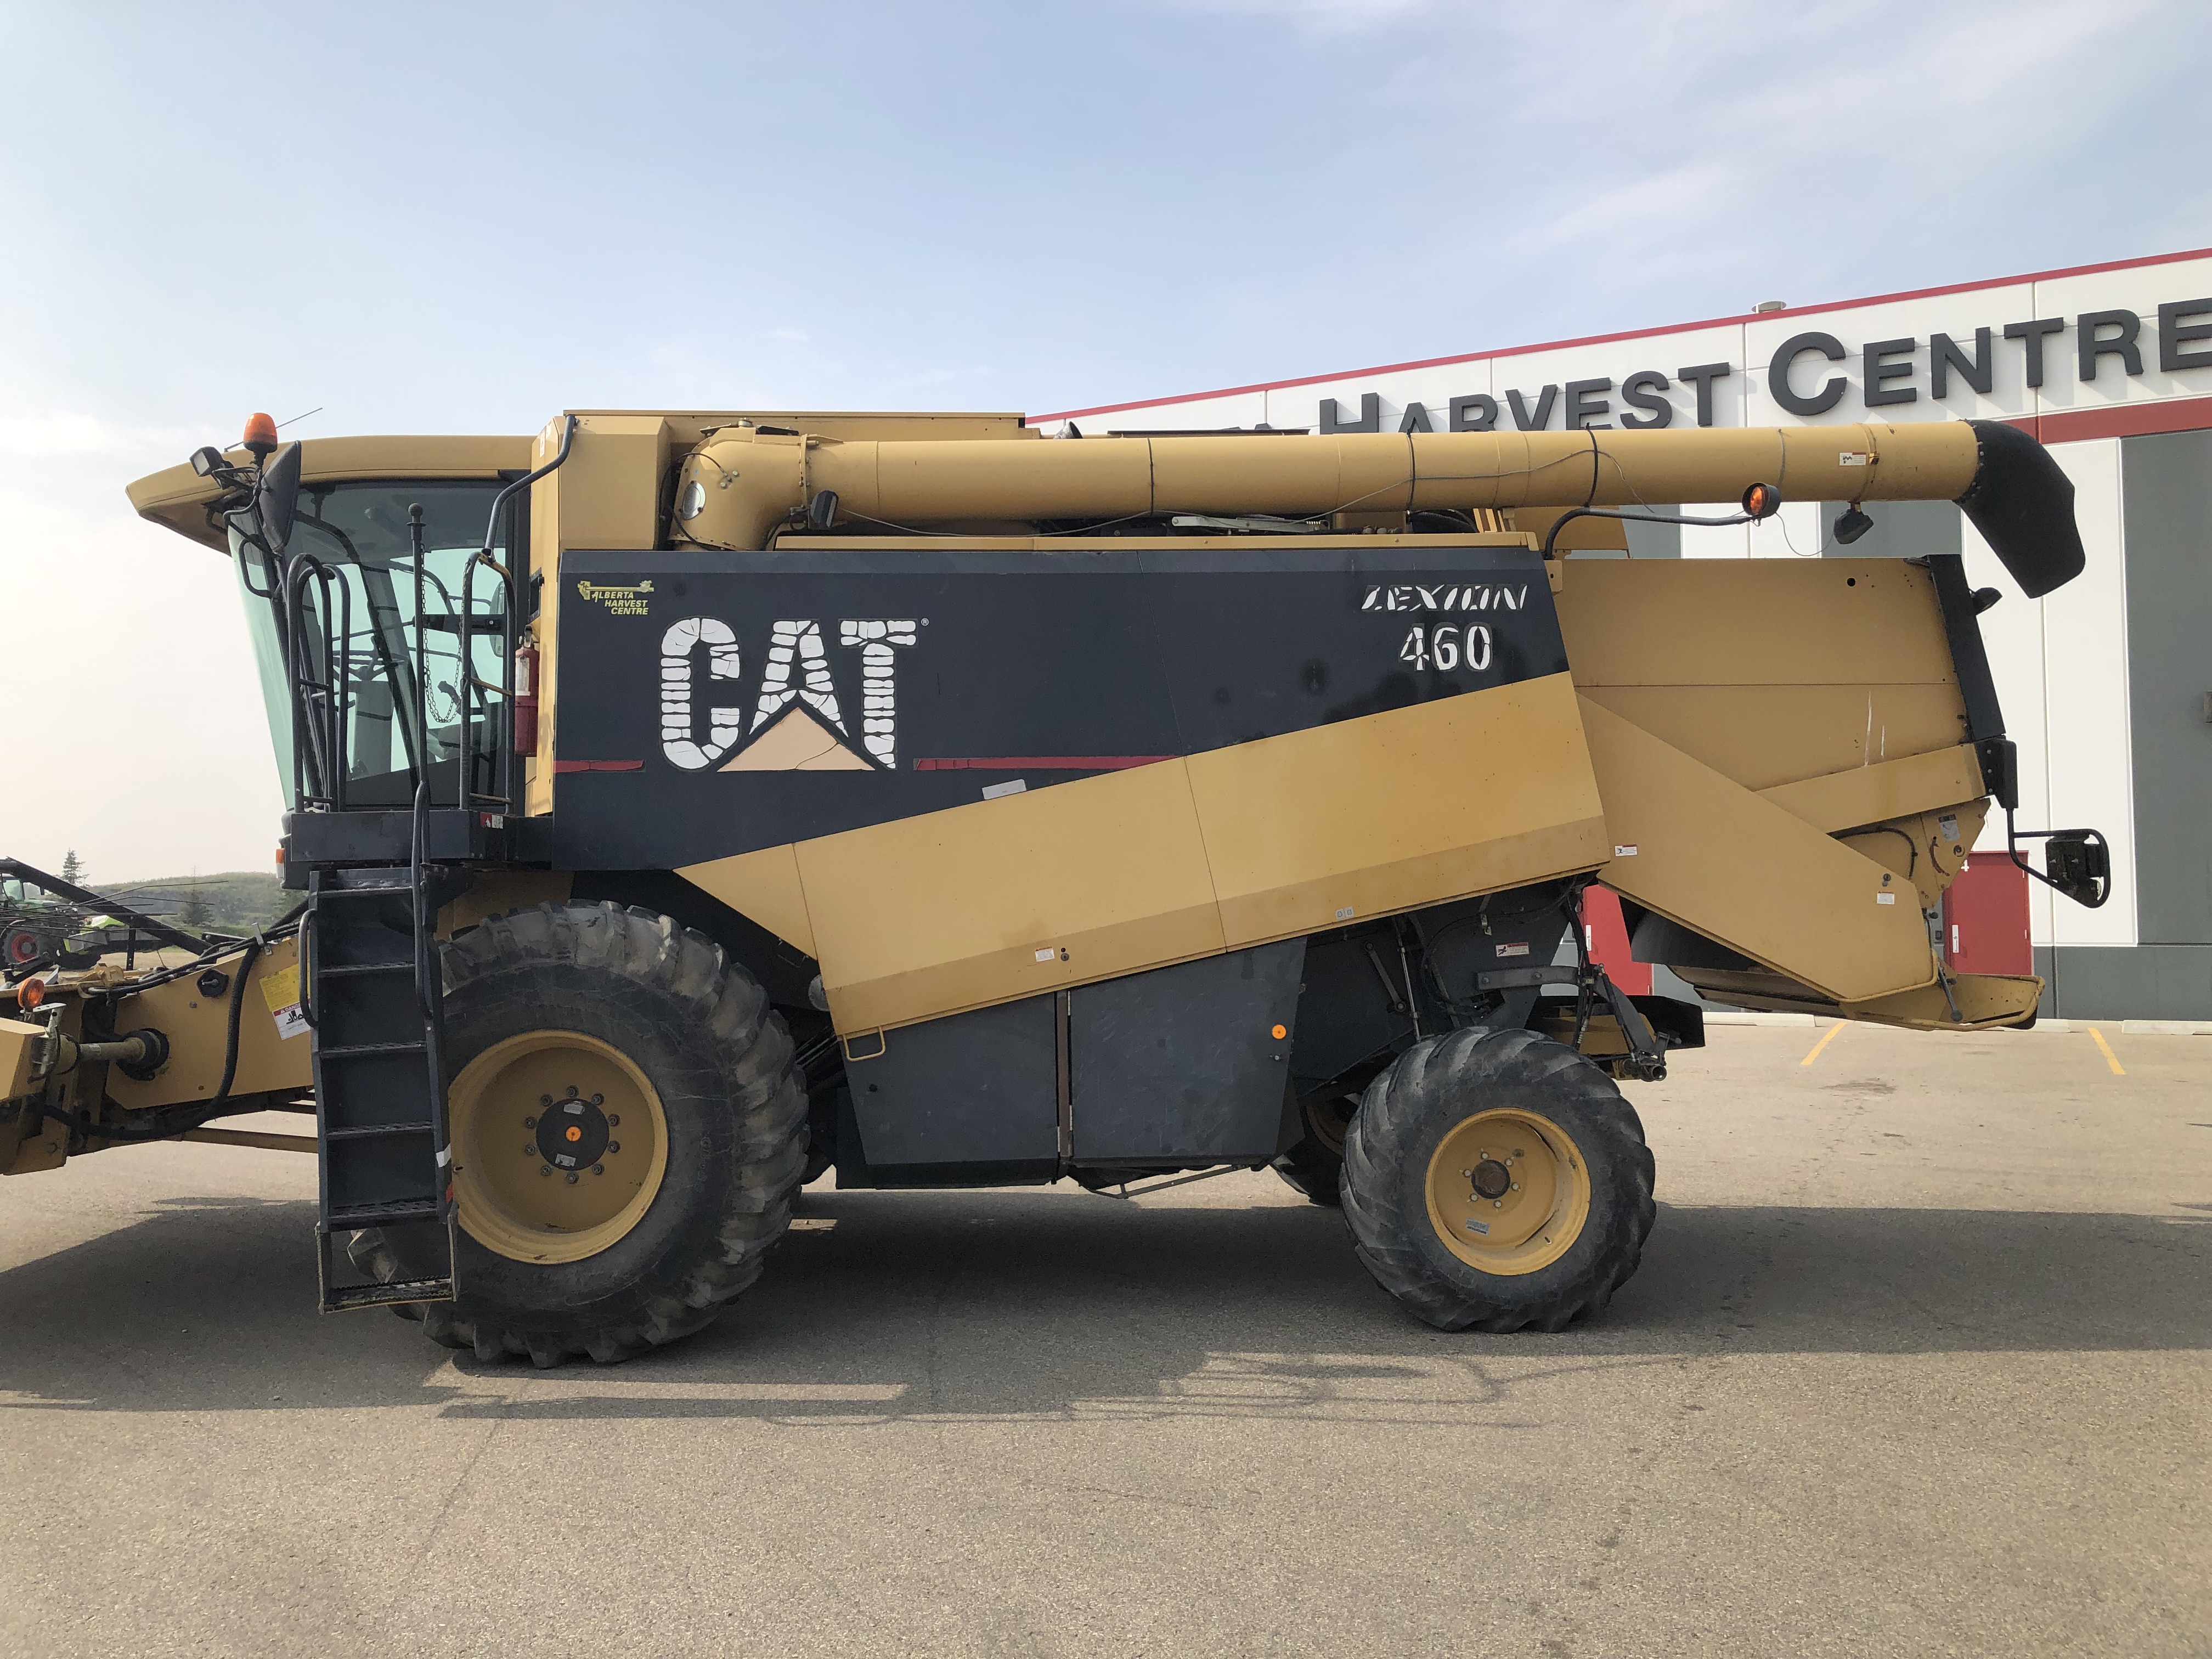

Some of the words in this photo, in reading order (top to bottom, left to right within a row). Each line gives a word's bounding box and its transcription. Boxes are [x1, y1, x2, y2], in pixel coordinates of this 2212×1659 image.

[1319, 362, 1730, 435] HARVEST
[1768, 297, 2212, 416] CENTRE
[592, 591, 634, 602] ALBERTA
[1400, 625, 1491, 670] 460
[661, 618, 917, 769] CAT
